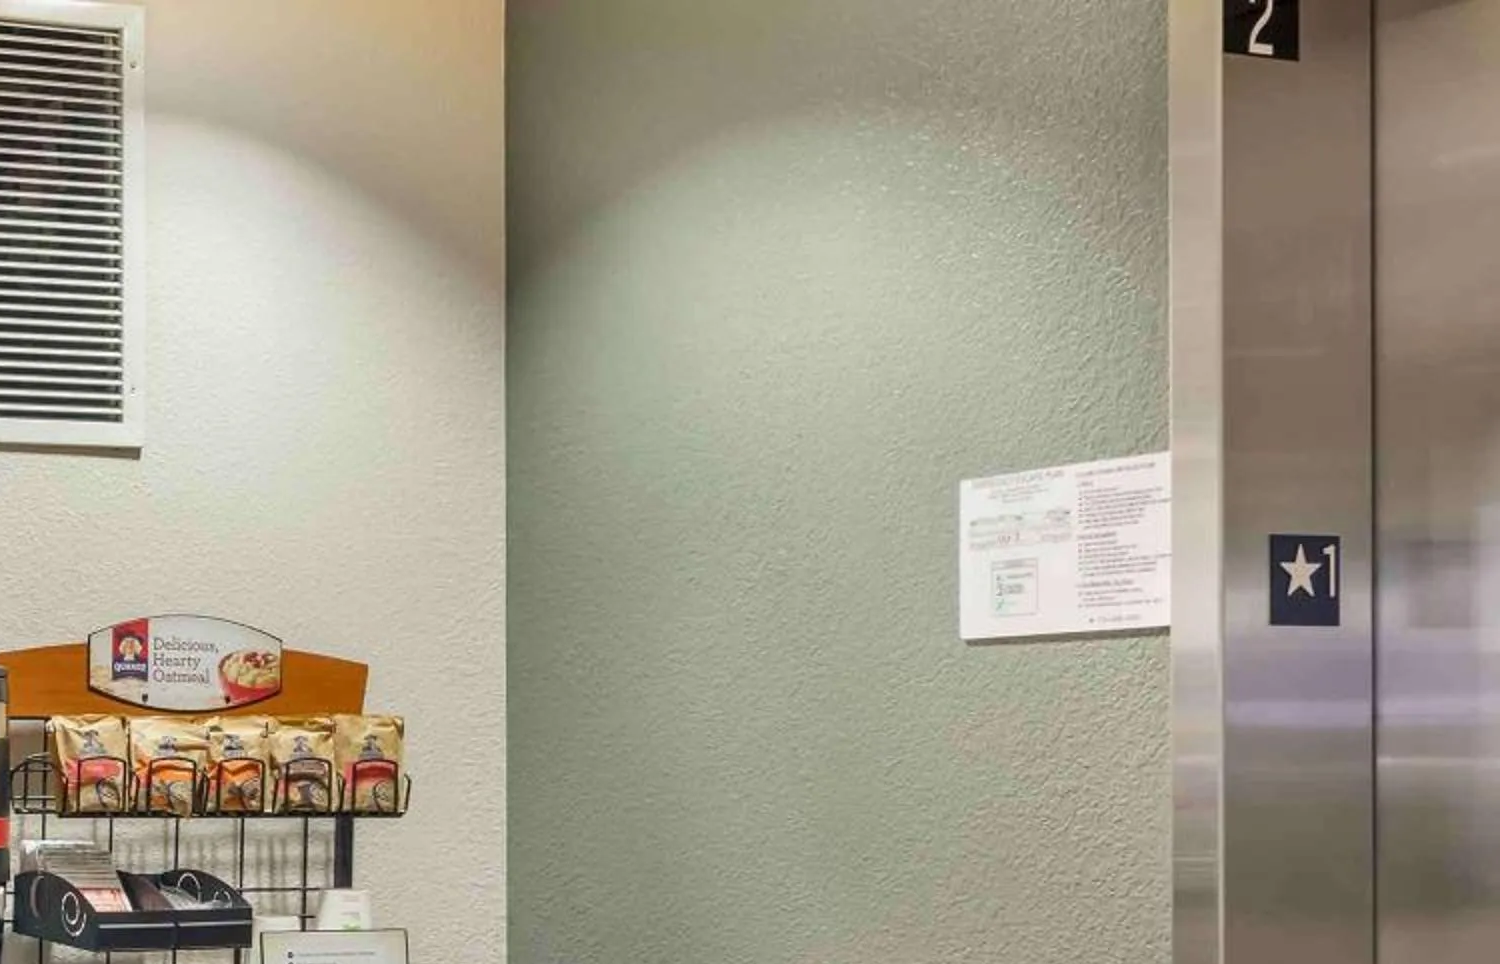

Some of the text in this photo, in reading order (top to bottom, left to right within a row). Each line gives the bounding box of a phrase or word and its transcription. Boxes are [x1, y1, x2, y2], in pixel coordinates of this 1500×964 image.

[1248, 0, 1274, 55] 2
[1322, 543, 1336, 598] 1
[153, 636, 219, 653] Delicious,
[153, 652, 201, 671] Hearty
[152, 668, 210, 684] Oatmeal
